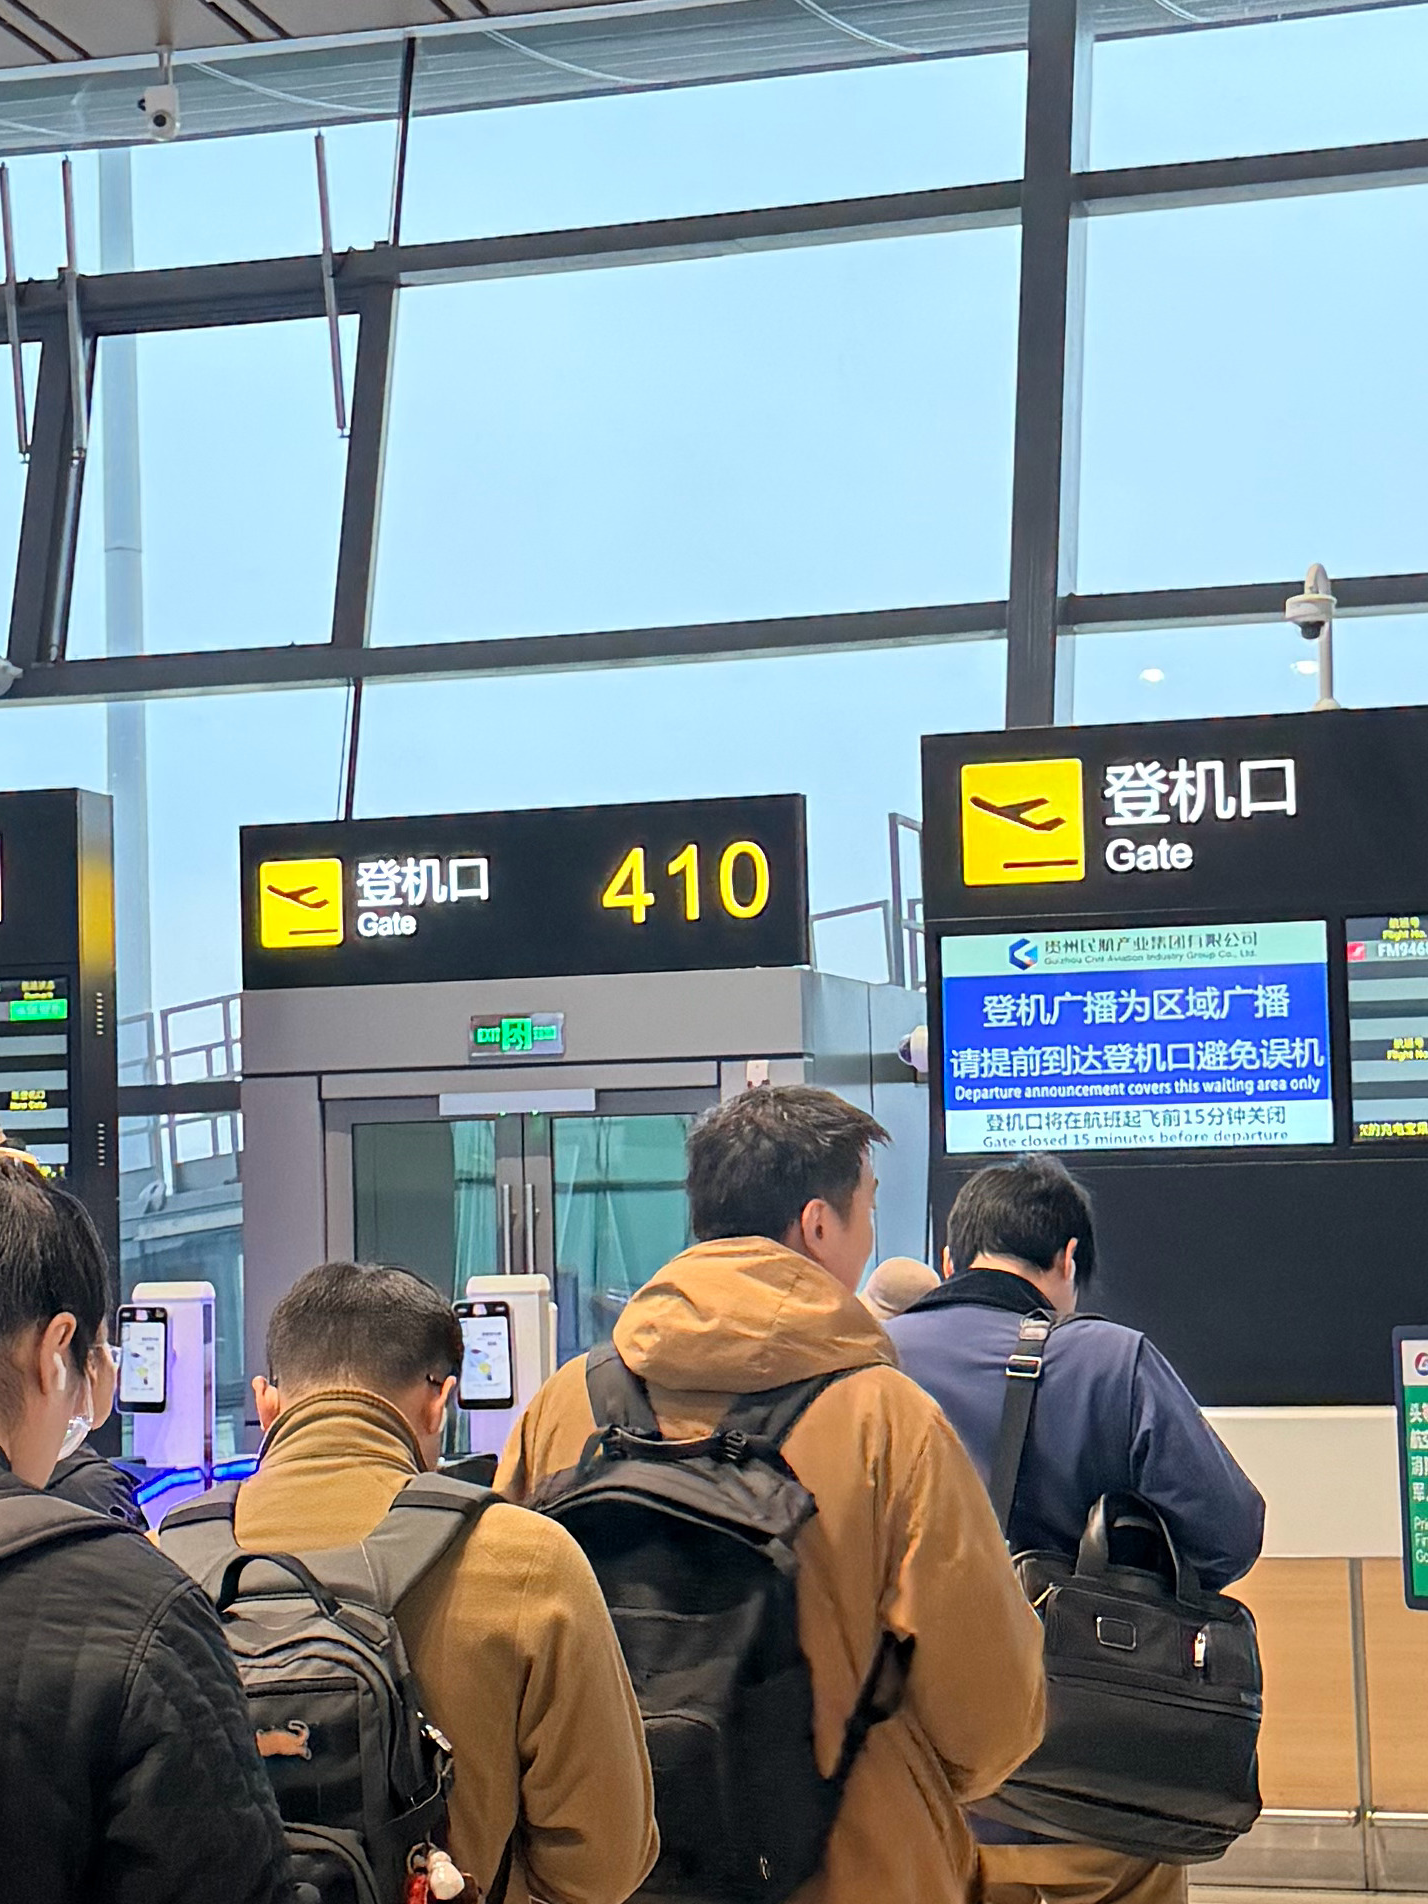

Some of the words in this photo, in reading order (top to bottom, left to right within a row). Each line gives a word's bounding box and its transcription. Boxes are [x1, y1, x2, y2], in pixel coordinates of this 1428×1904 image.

[1103, 758, 1297, 829] 登机口
[1104, 838, 1194, 874] Gate
[356, 856, 490, 907] 登机口
[601, 840, 771, 925] 410
[356, 911, 418, 938] Gate
[982, 983, 1291, 1029] 登机广播为区域广播
[949, 1036, 1325, 1080] 请提前到达登机口避免误机
[954, 1084, 1022, 1103] Departure
[1024, 1082, 1125, 1099] announcement
[1127, 1082, 1172, 1096] covers
[1173, 1080, 1200, 1095] this
[1202, 1077, 1254, 1096] waiting
[1257, 1079, 1287, 1093] area
[1289, 1075, 1321, 1093] only
[983, 1135, 1017, 1148] Gate
[1020, 1132, 1068, 1146] closed
[1073, 1133, 1089, 1145] 15
[1094, 1132, 1155, 1145] minutes
[1159, 1130, 1210, 1143] before
[1214, 1129, 1289, 1146] departure
[986, 1105, 1287, 1132] 登机口将在航班起飞前15分钟关闭
